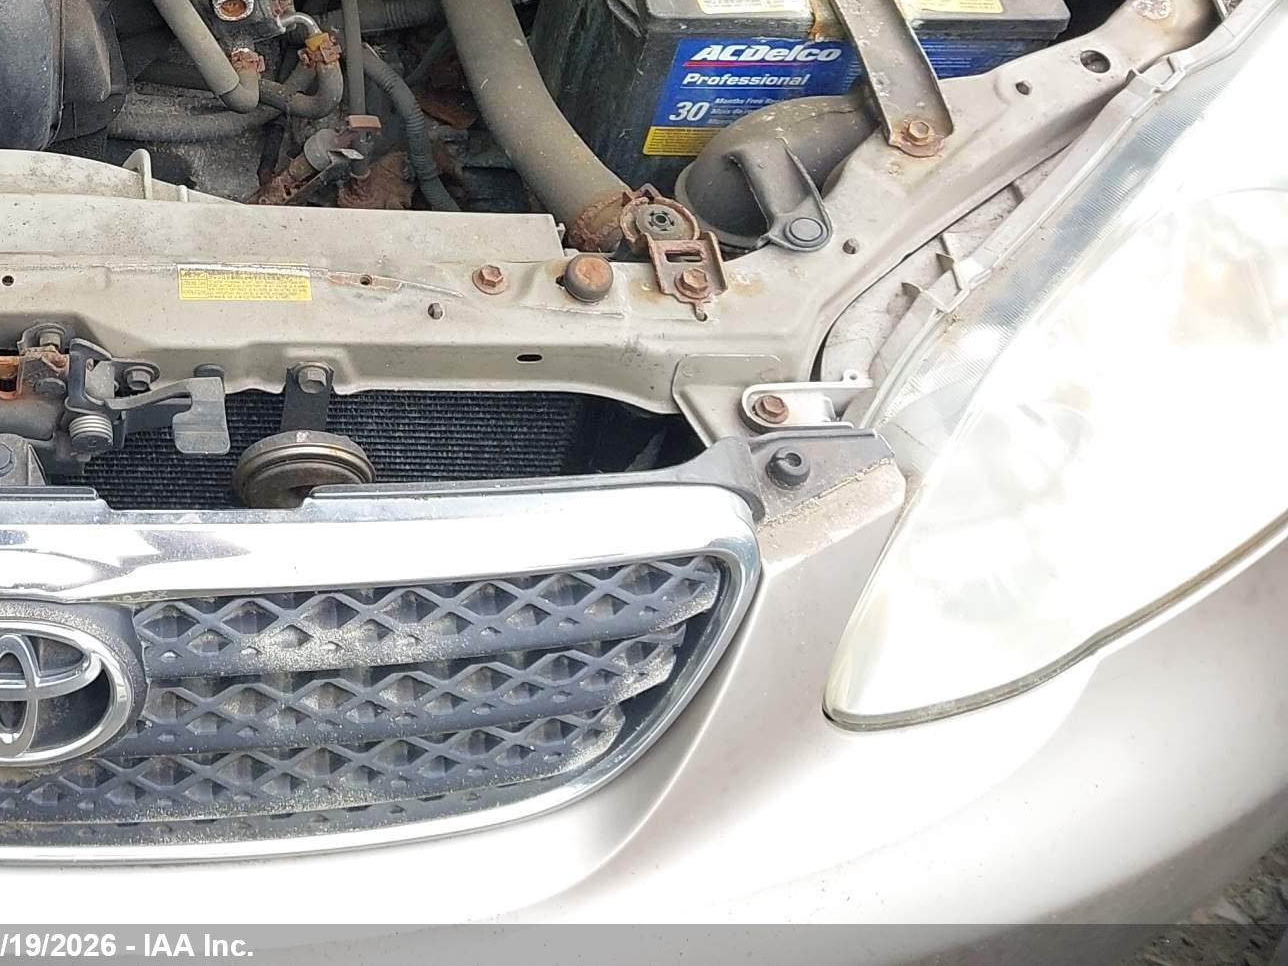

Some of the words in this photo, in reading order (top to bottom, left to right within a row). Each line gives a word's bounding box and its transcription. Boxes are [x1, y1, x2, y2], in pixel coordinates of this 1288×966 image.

[690, 44, 842, 62] ACDelco
[682, 72, 811, 86] Professional
[668, 101, 710, 121] 30
